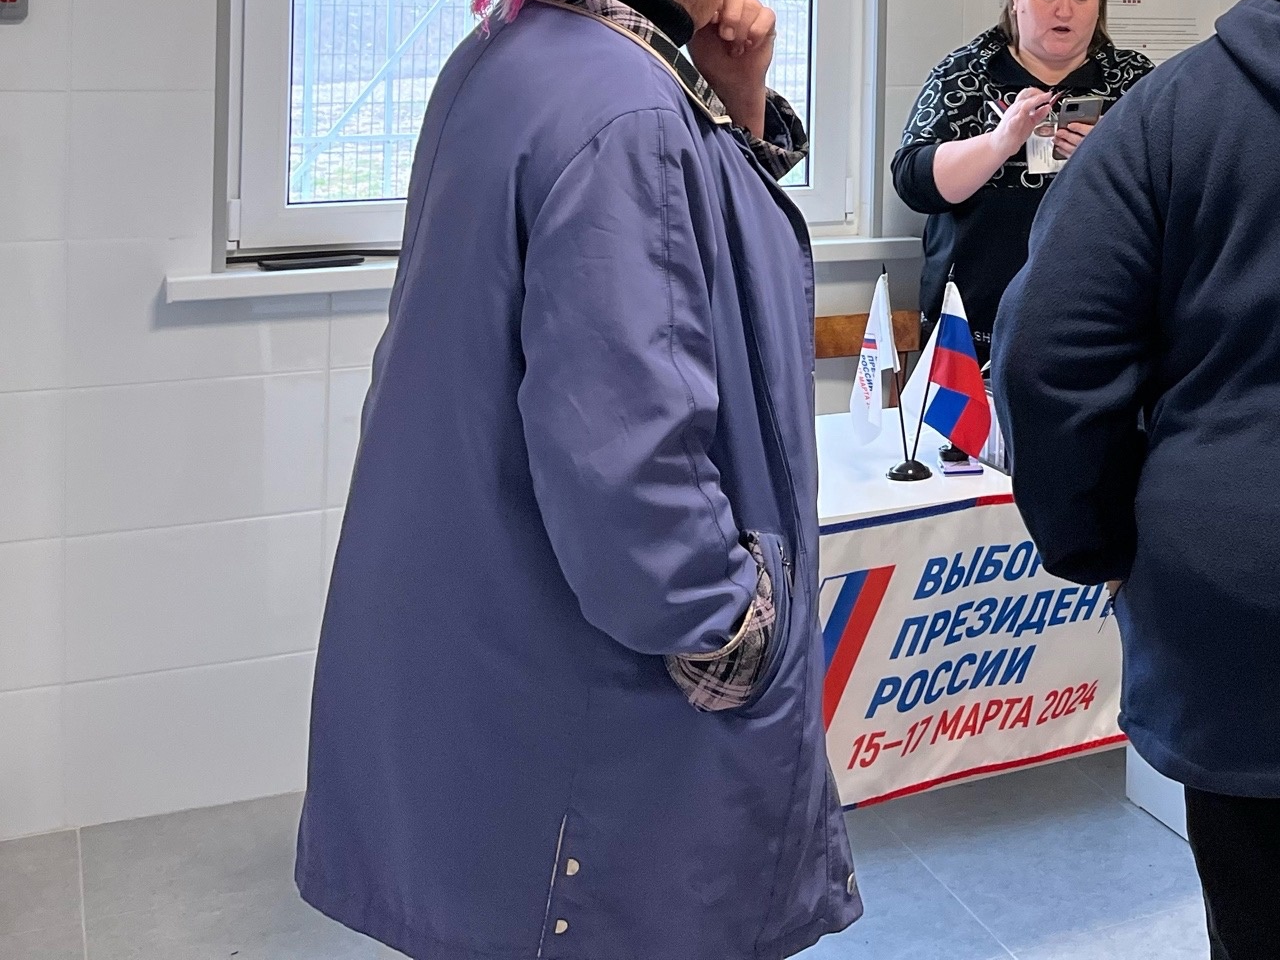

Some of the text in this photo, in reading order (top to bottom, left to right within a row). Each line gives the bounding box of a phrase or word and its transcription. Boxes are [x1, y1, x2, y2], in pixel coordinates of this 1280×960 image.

[864, 644, 1037, 719] РОССИИ
[930, 696, 1034, 745] МАРТА
[1036, 680, 1099, 726] 2024
